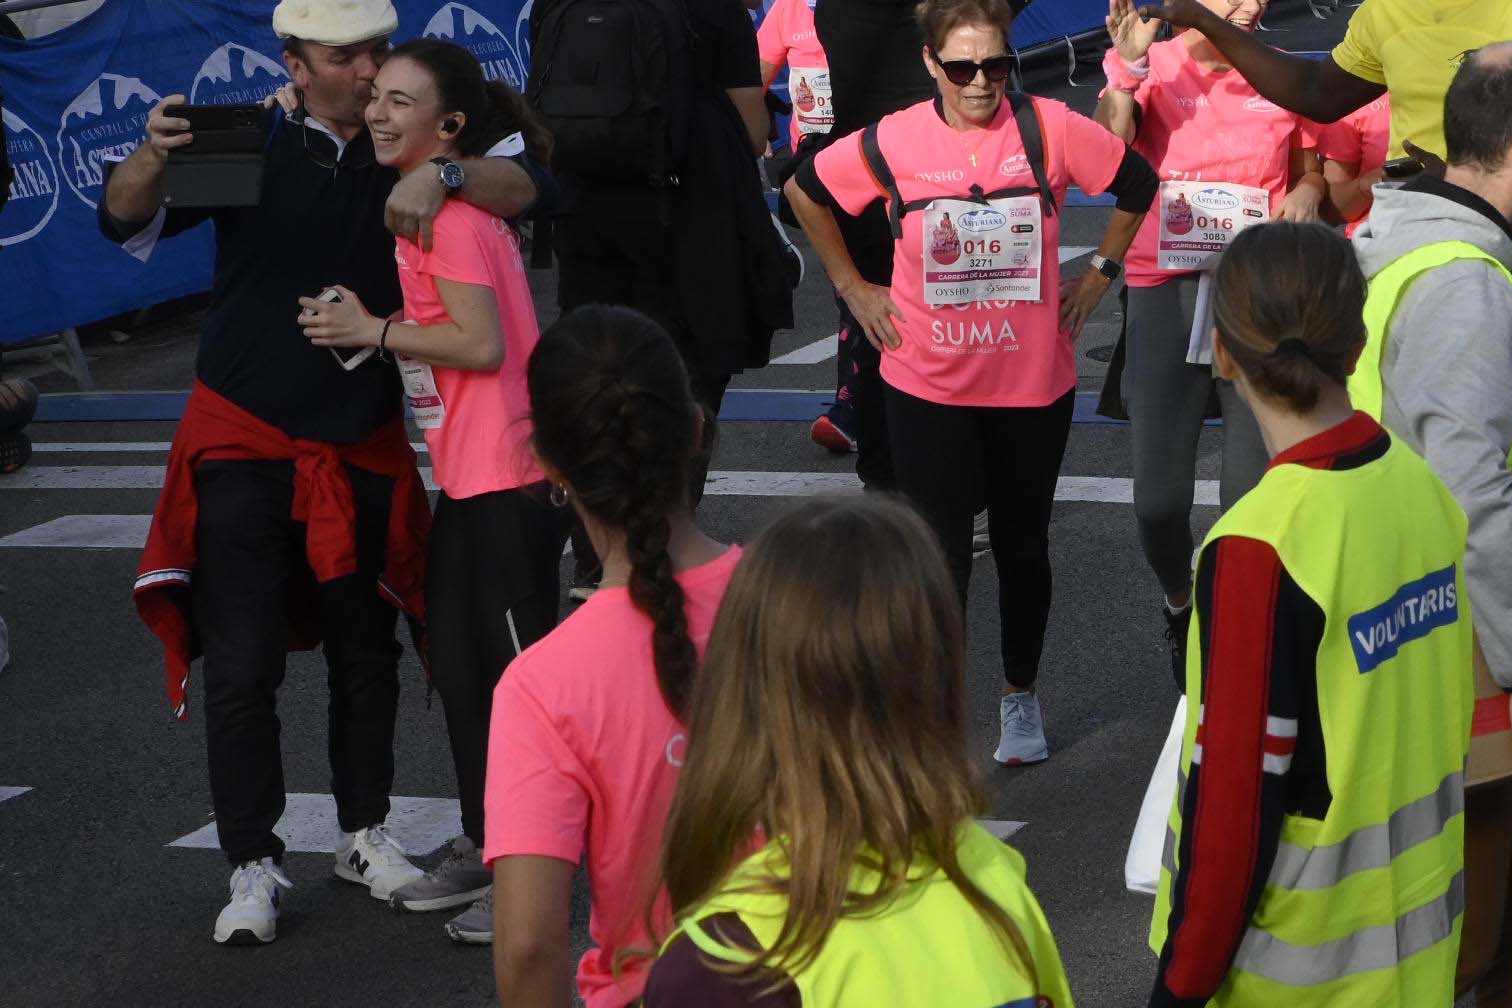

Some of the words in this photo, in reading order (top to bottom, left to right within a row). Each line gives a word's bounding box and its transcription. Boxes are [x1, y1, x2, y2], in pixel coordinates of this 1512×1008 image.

[1197, 216, 1233, 230] 016
[1203, 233, 1226, 241] 3083
[964, 240, 1001, 254] 016
[970, 259, 993, 267] 3271
[1168, 255, 1202, 263] OYSHO
[938, 273, 969, 281] CARRERA
[935, 287, 969, 297] OYSHO
[995, 284, 1031, 292] Santander
[931, 320, 1016, 345] SUMA
[1356, 583, 1457, 655] VOLUNTARIS
